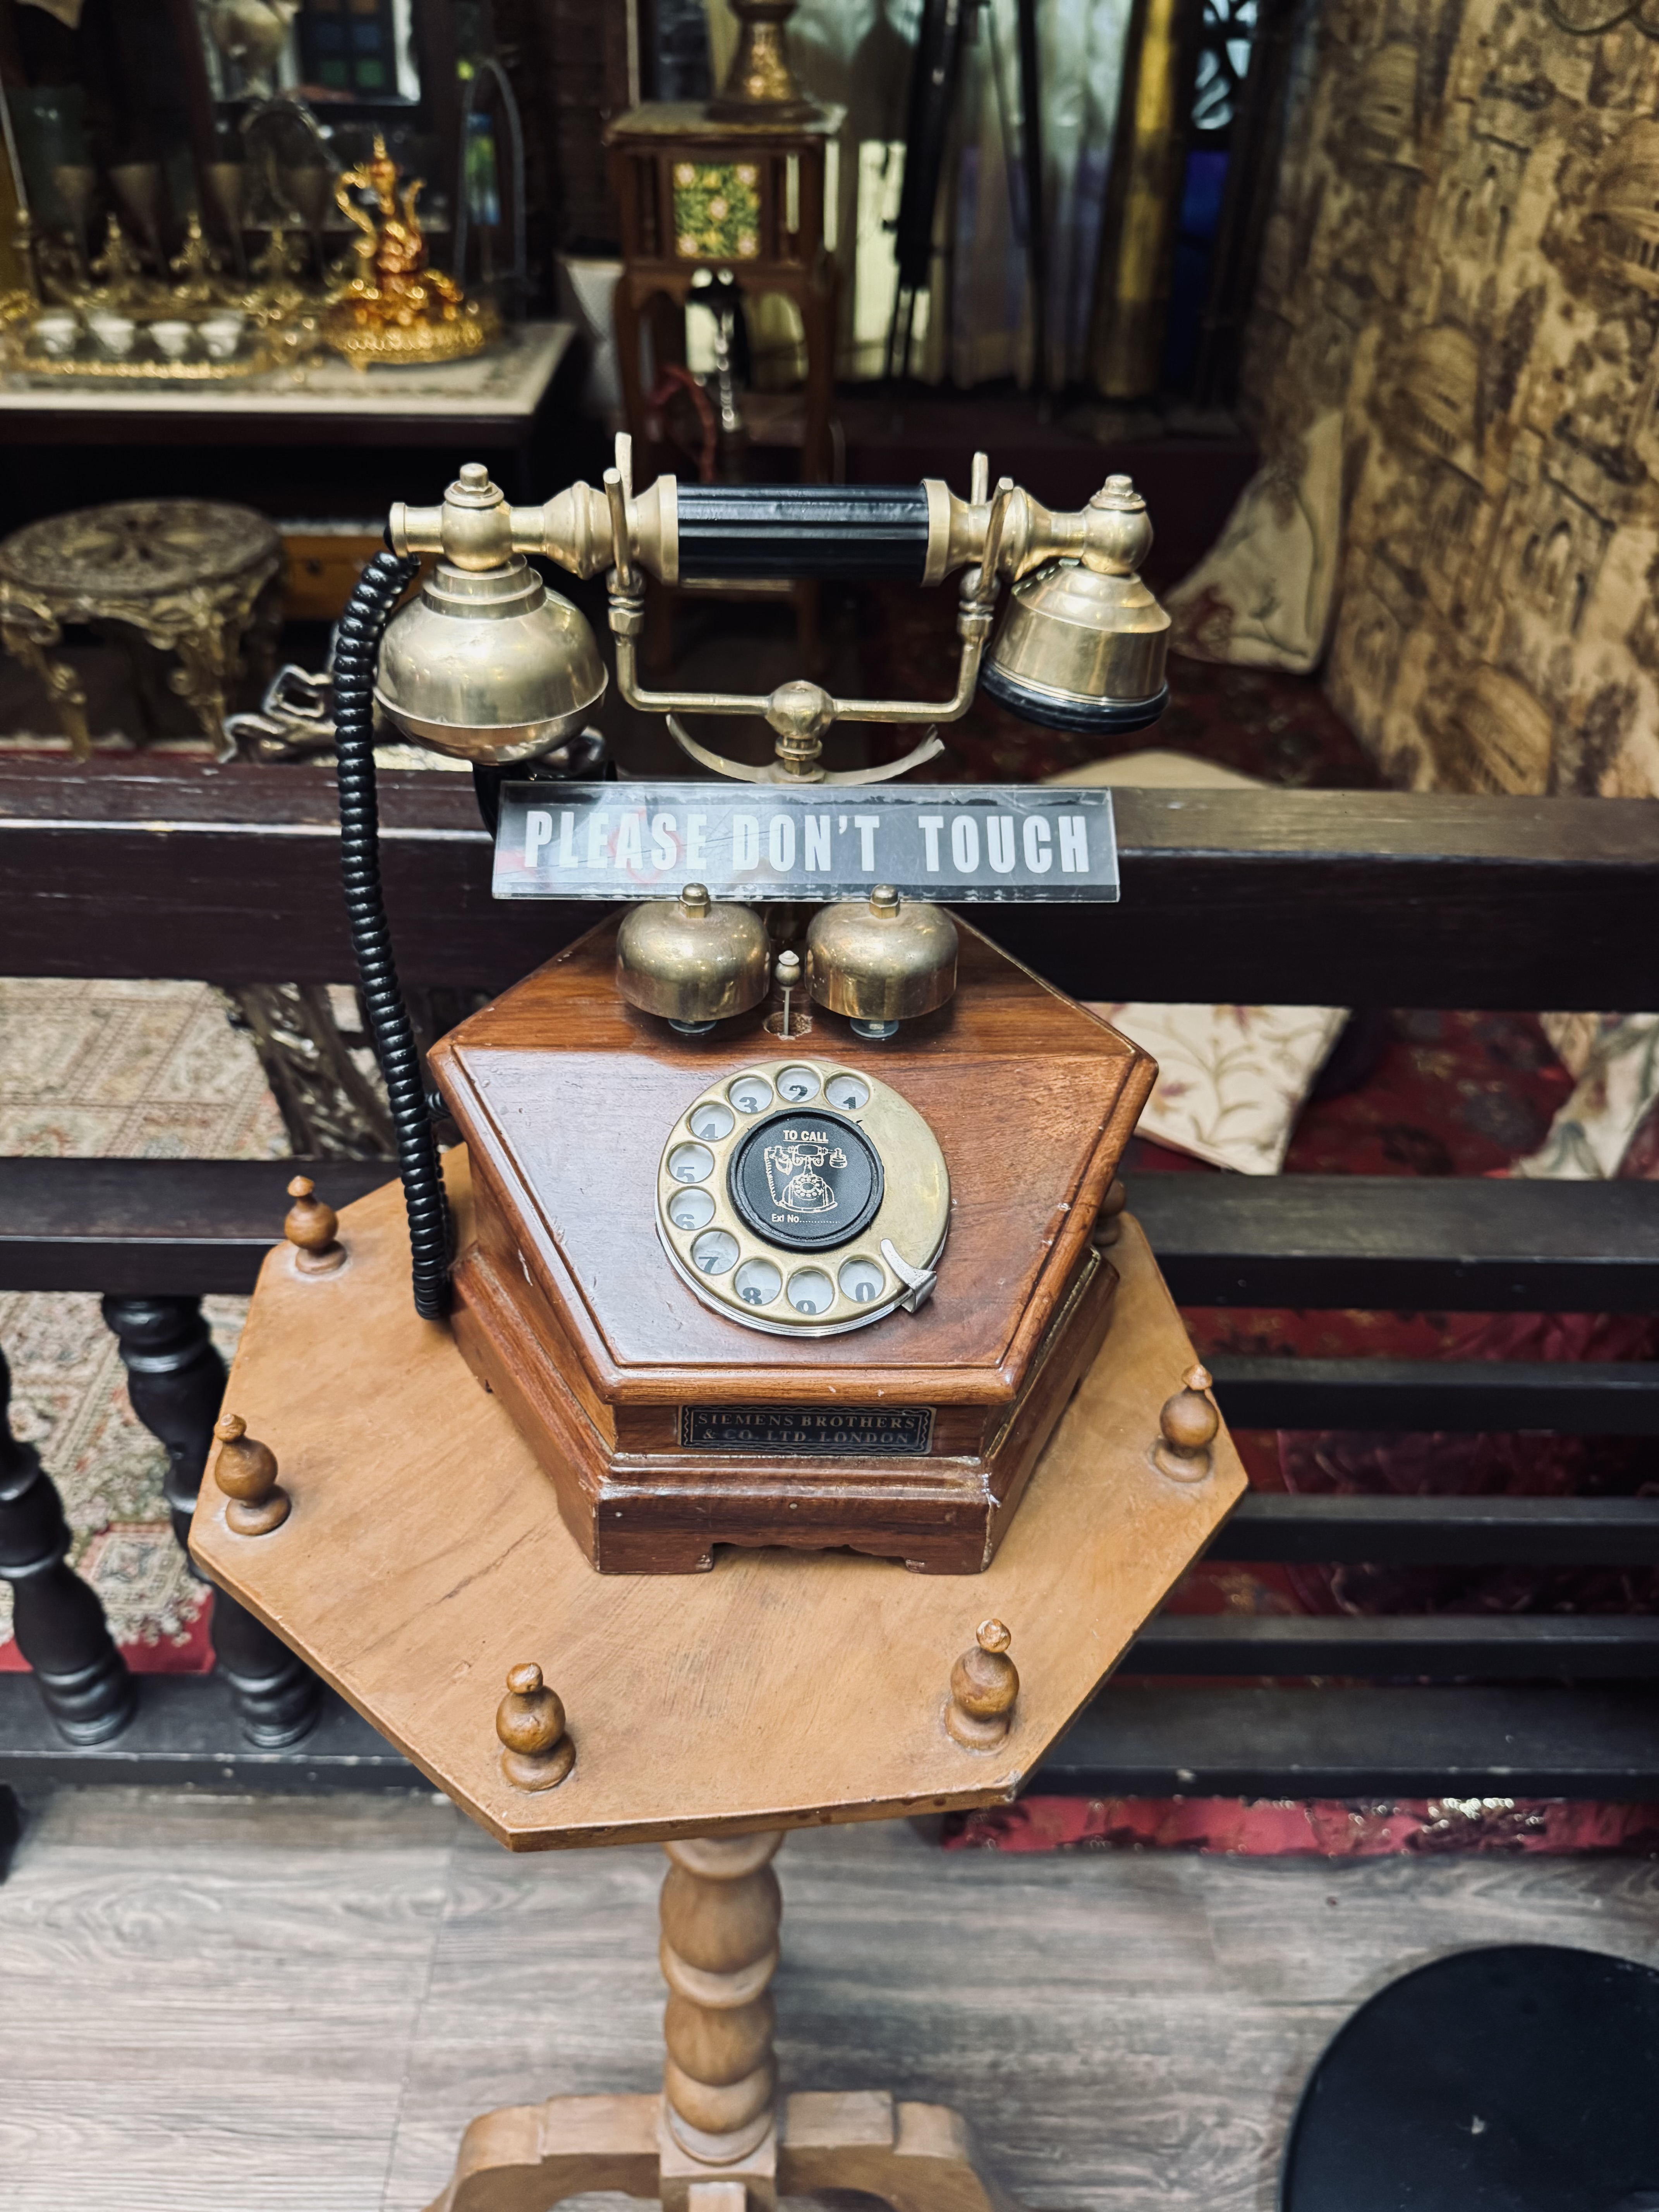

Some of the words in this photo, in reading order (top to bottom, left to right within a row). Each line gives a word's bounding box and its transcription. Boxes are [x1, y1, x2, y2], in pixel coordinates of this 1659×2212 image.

[524, 811, 707, 871] PLEASE
[732, 814, 880, 872] DON'T
[918, 815, 1089, 873] TOUCH
[739, 1097, 758, 1113] 3
[783, 1130, 798, 1140] TO
[800, 1130, 829, 1142] CALL
[676, 1166, 695, 1183] 5
[698, 1256, 719, 1273] 7
[742, 1287, 763, 1305] 8
[698, 1413, 793, 1426] SIEMENS
[800, 1415, 915, 1428] BROTHERS
[702, 1428, 716, 1439] &
[818, 1431, 908, 1444] LONDON
